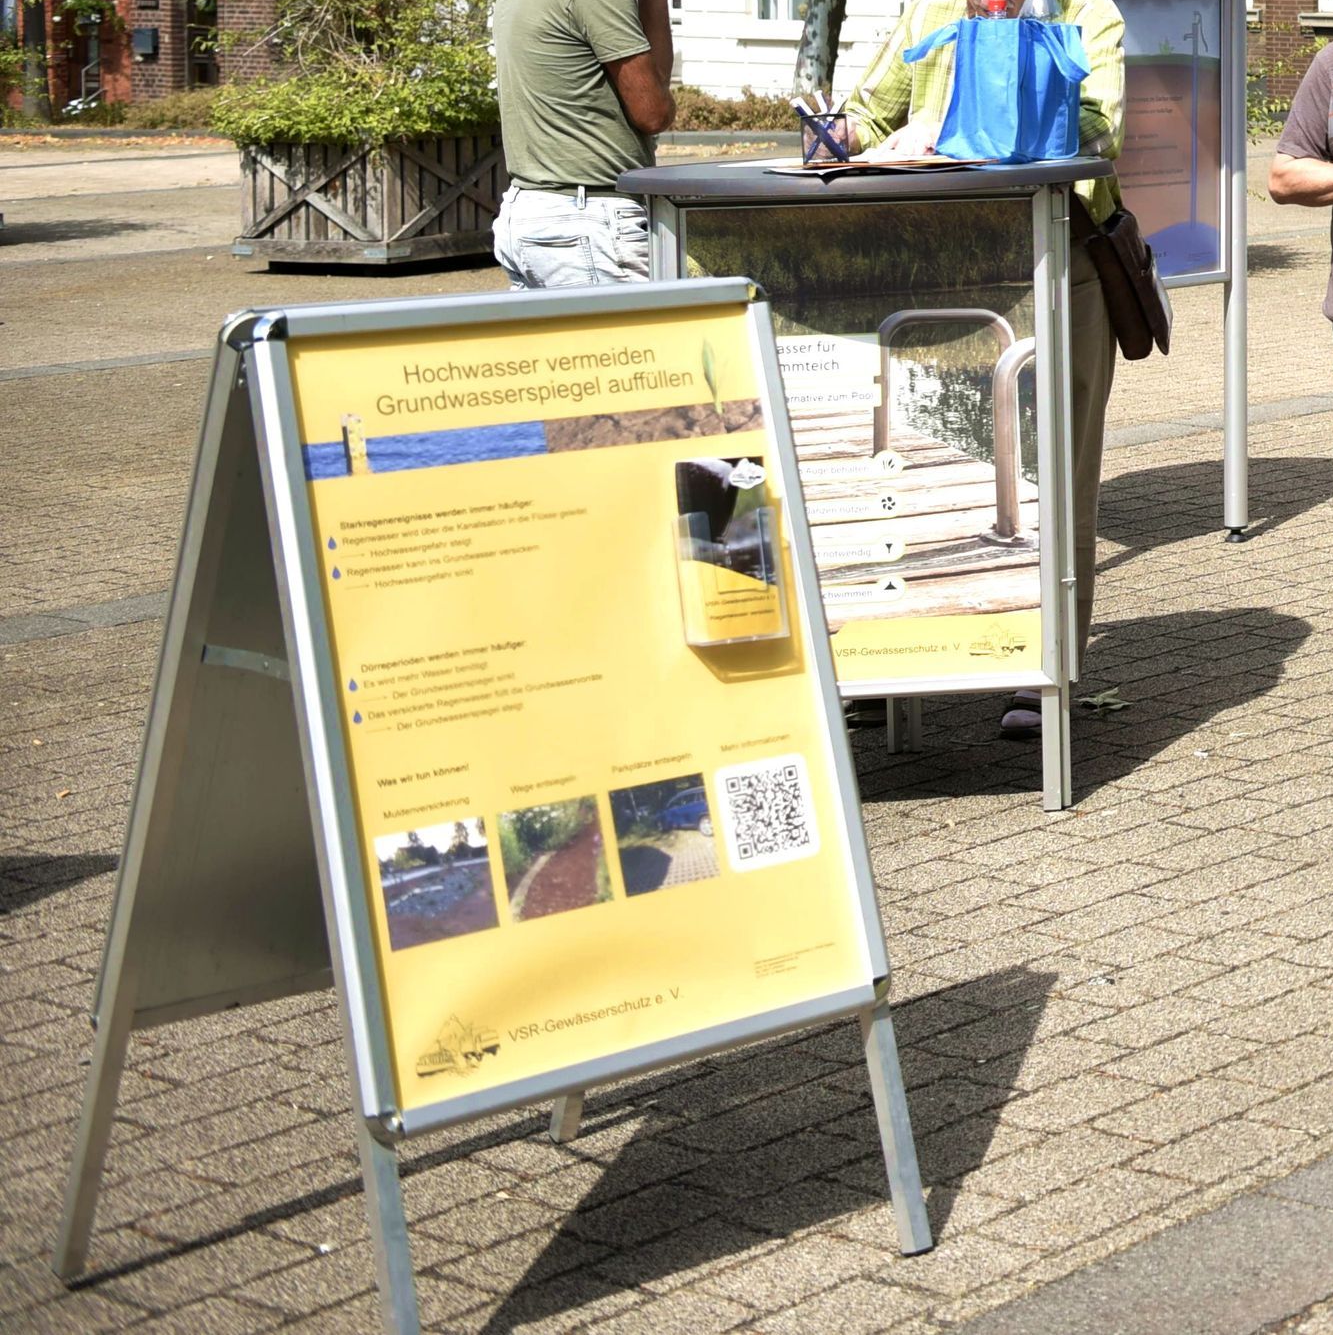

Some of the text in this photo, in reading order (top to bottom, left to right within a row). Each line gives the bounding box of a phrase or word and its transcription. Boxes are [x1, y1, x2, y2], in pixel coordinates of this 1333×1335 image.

[403, 346, 656, 386] Hochwasser vermeiden
[376, 369, 694, 416] Grundwasserspiegel auffüllen
[827, 394, 848, 402] zum
[340, 512, 433, 532] Starkregenereignisse
[435, 507, 467, 519] werden
[469, 503, 496, 514] immer
[342, 530, 400, 547] Regenwasser
[402, 527, 419, 539] wird
[421, 524, 443, 537] über
[445, 524, 455, 534] die
[457, 516, 506, 532] Kanalisation
[370, 540, 447, 559] Hochwassergefahr
[347, 562, 404, 579] Regenwasser
[406, 558, 427, 570] kann
[429, 556, 442, 566] ins
[443, 549, 497, 566] Grundwasser
[375, 570, 452, 590] Hochwassergefahr
[361, 655, 425, 674] Dürreperioden
[428, 649, 460, 662] werden
[462, 646, 489, 657] immer
[363, 680, 375, 690] Es
[377, 676, 396, 687] wird
[398, 673, 420, 684] mehr
[421, 667, 453, 680] Wasser
[392, 689, 408, 701] Der
[410, 676, 495, 699] Grundwasserspiegel
[368, 710, 385, 721] Das
[387, 701, 434, 718] versickerte
[437, 692, 492, 710] Regenwasser
[511, 685, 523, 696] die
[397, 720, 413, 732] Der
[415, 707, 500, 730] Grundwasserspiegel
[720, 742, 739, 753] Mehr
[377, 762, 470, 789] Was wir tun können!
[611, 761, 652, 775] Parkplätze
[510, 781, 534, 796] Wege
[383, 795, 470, 820] Muldenversickerung
[508, 996, 652, 1043] VSR-Gewässerschutz
